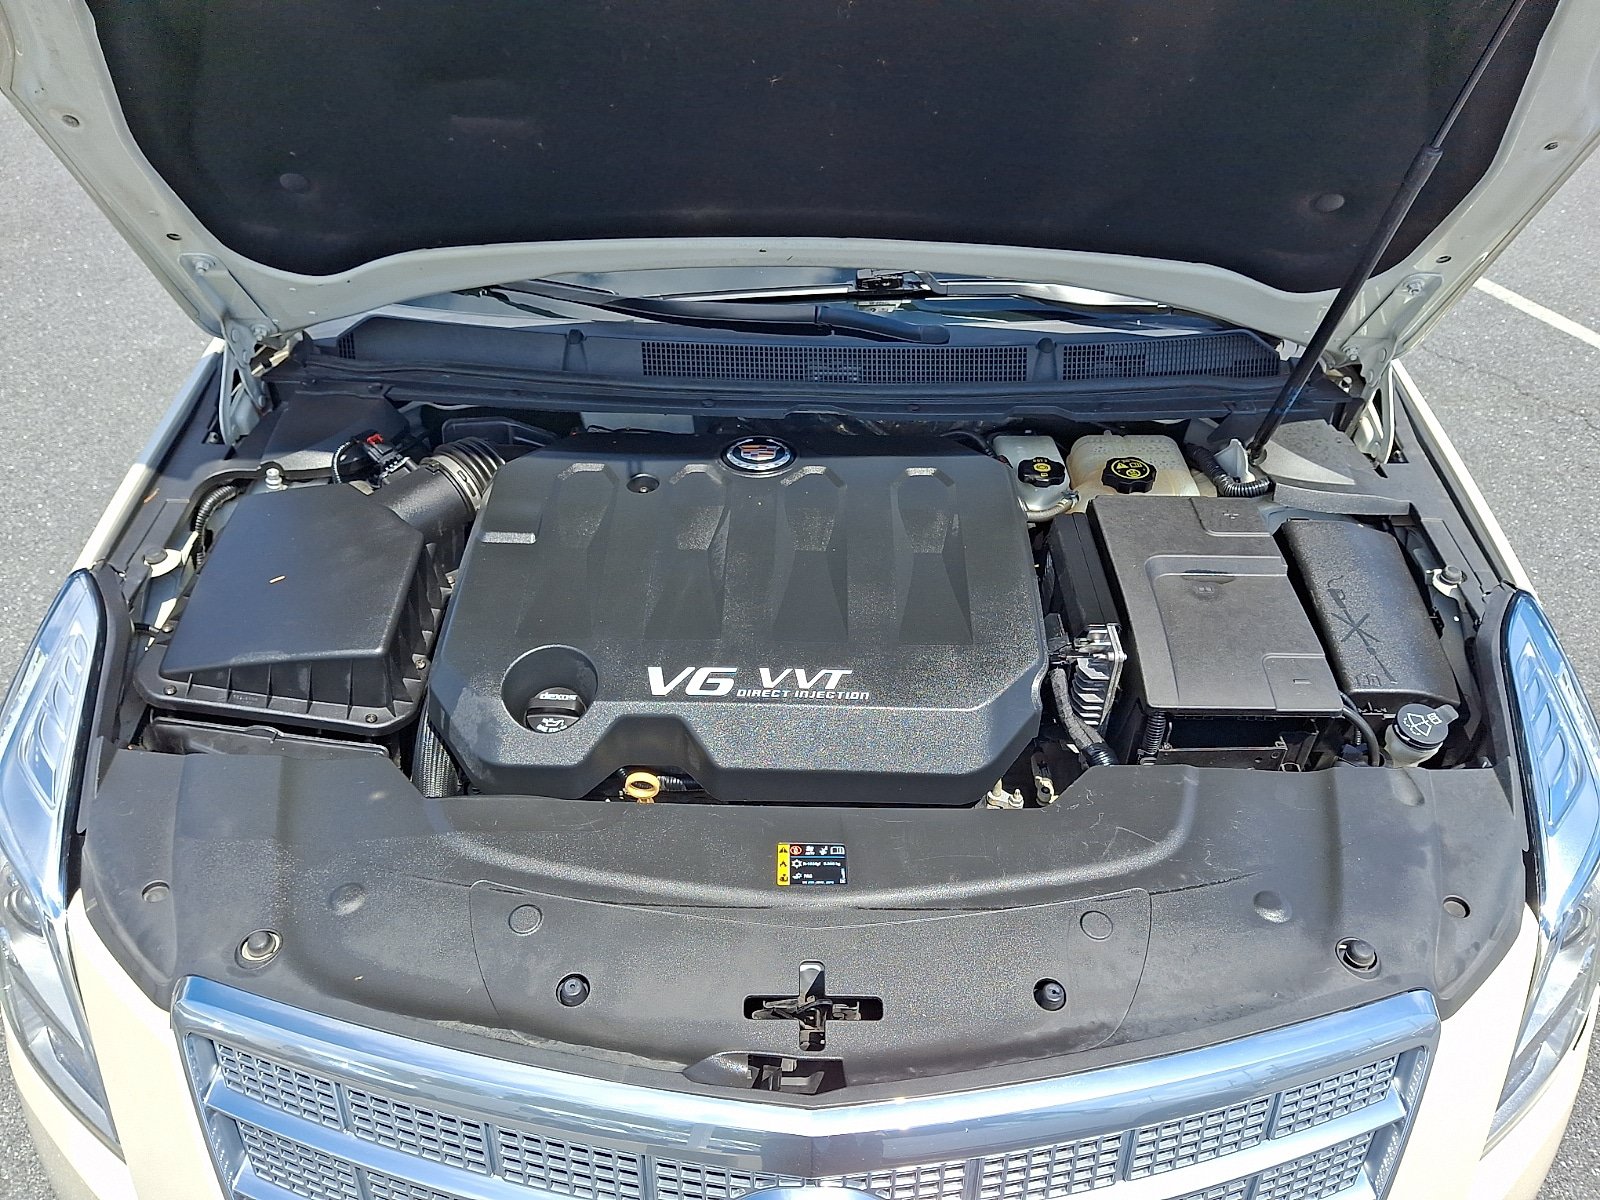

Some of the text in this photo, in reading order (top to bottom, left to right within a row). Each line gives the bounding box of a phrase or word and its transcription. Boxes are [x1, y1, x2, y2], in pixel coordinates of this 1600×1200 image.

[648, 667, 852, 696] V6 VVT
[736, 689, 870, 700] DIRECT INJECTION
